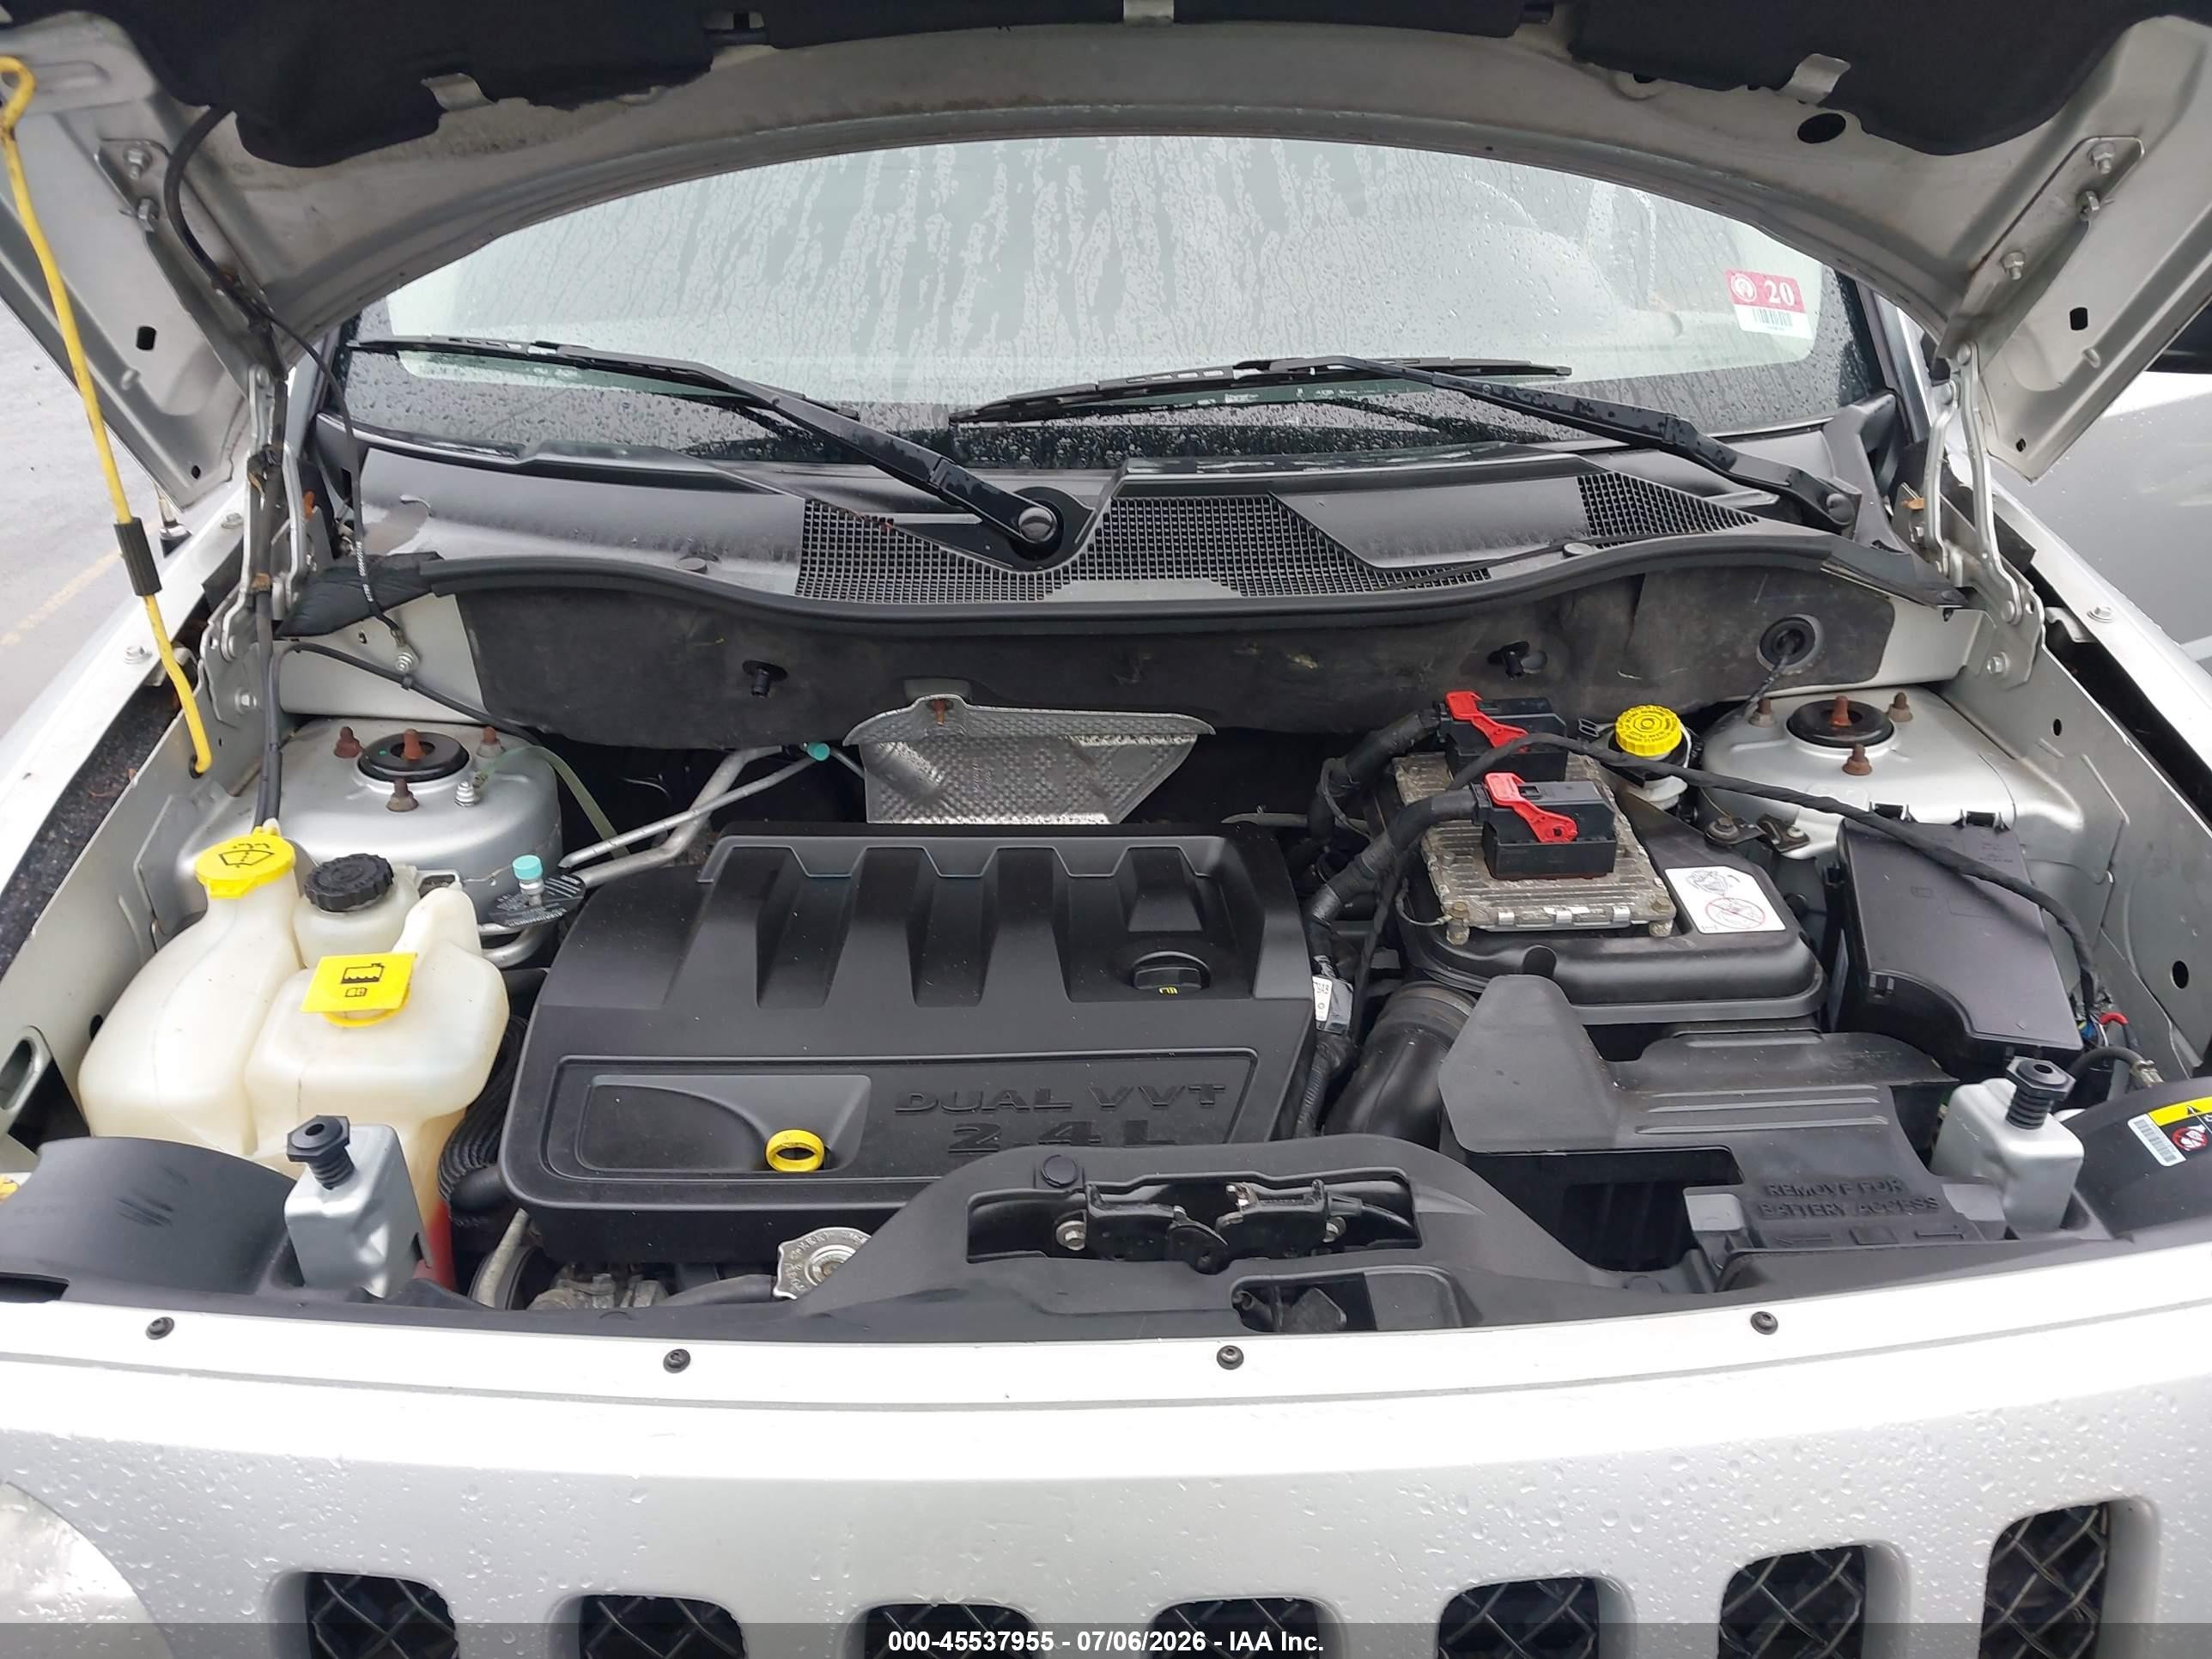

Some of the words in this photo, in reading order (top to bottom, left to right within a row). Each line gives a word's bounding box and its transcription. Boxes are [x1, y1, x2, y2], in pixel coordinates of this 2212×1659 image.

[1764, 279, 1796, 307] 20
[893, 1085, 1073, 1112] DUAL
[1087, 1083, 1226, 1109] VVT
[1765, 1182, 1853, 1197] REMOVE
[1856, 1179, 1902, 1194] FOR
[1758, 1202, 1847, 1218] BATTERY
[1856, 1196, 1939, 1214] ACCESS
